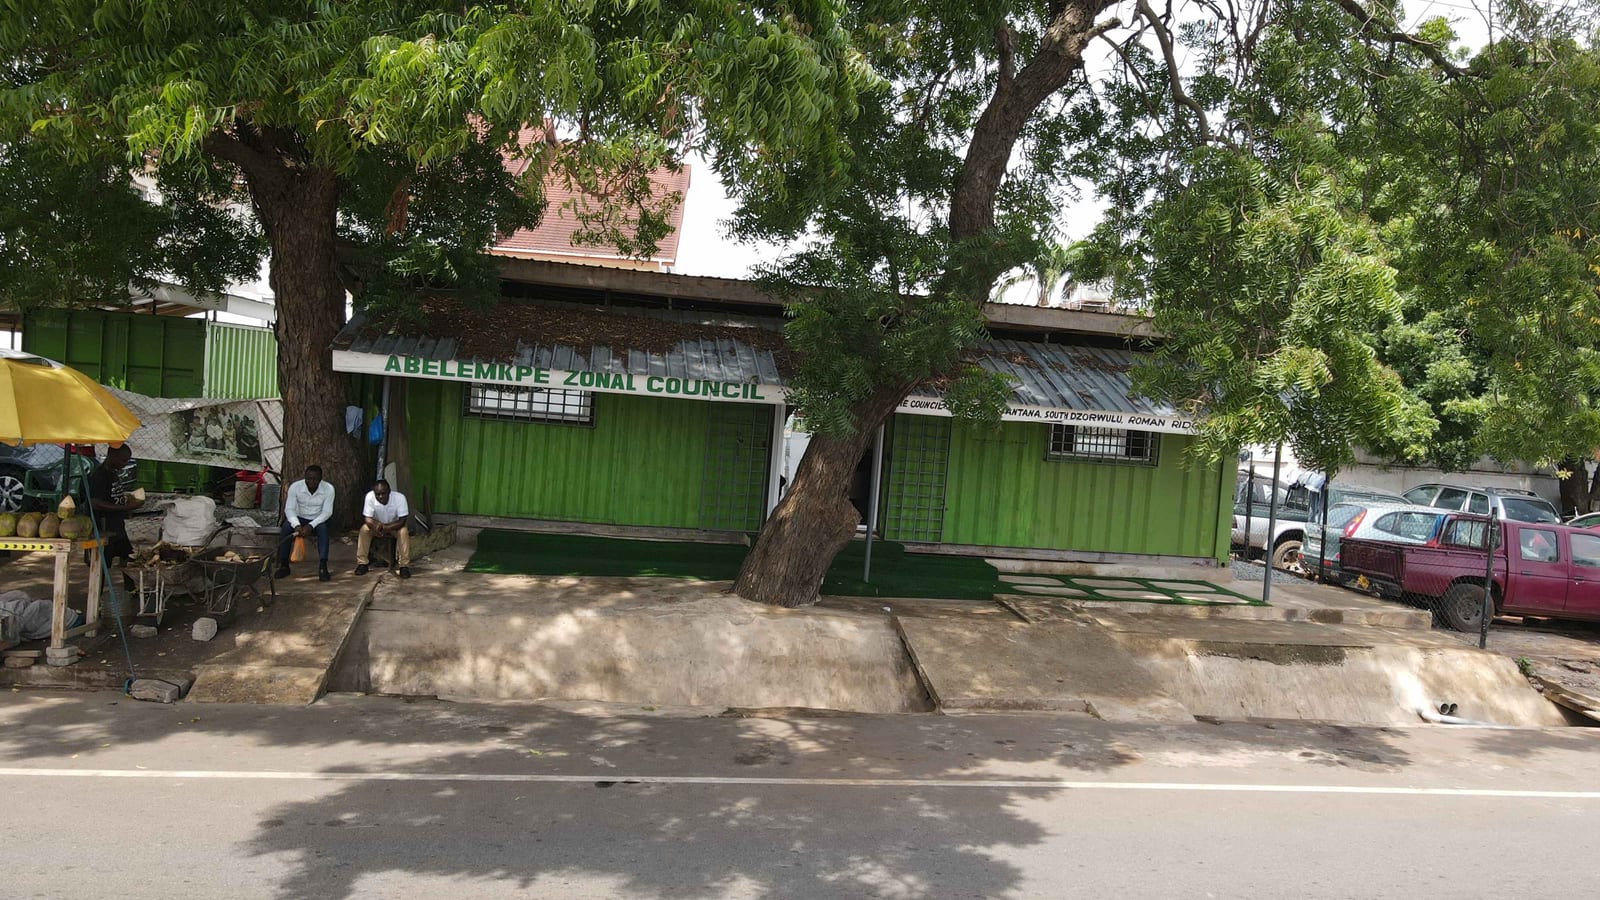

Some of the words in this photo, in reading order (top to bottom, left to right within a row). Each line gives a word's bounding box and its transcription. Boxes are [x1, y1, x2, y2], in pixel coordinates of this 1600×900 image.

[384, 354, 550, 384] ABELEMKPE
[563, 370, 636, 391] ZONAL
[646, 376, 765, 400] COUNCIL
[1045, 411, 1069, 420] SOUTH
[1128, 416, 1166, 427] ROMAN
